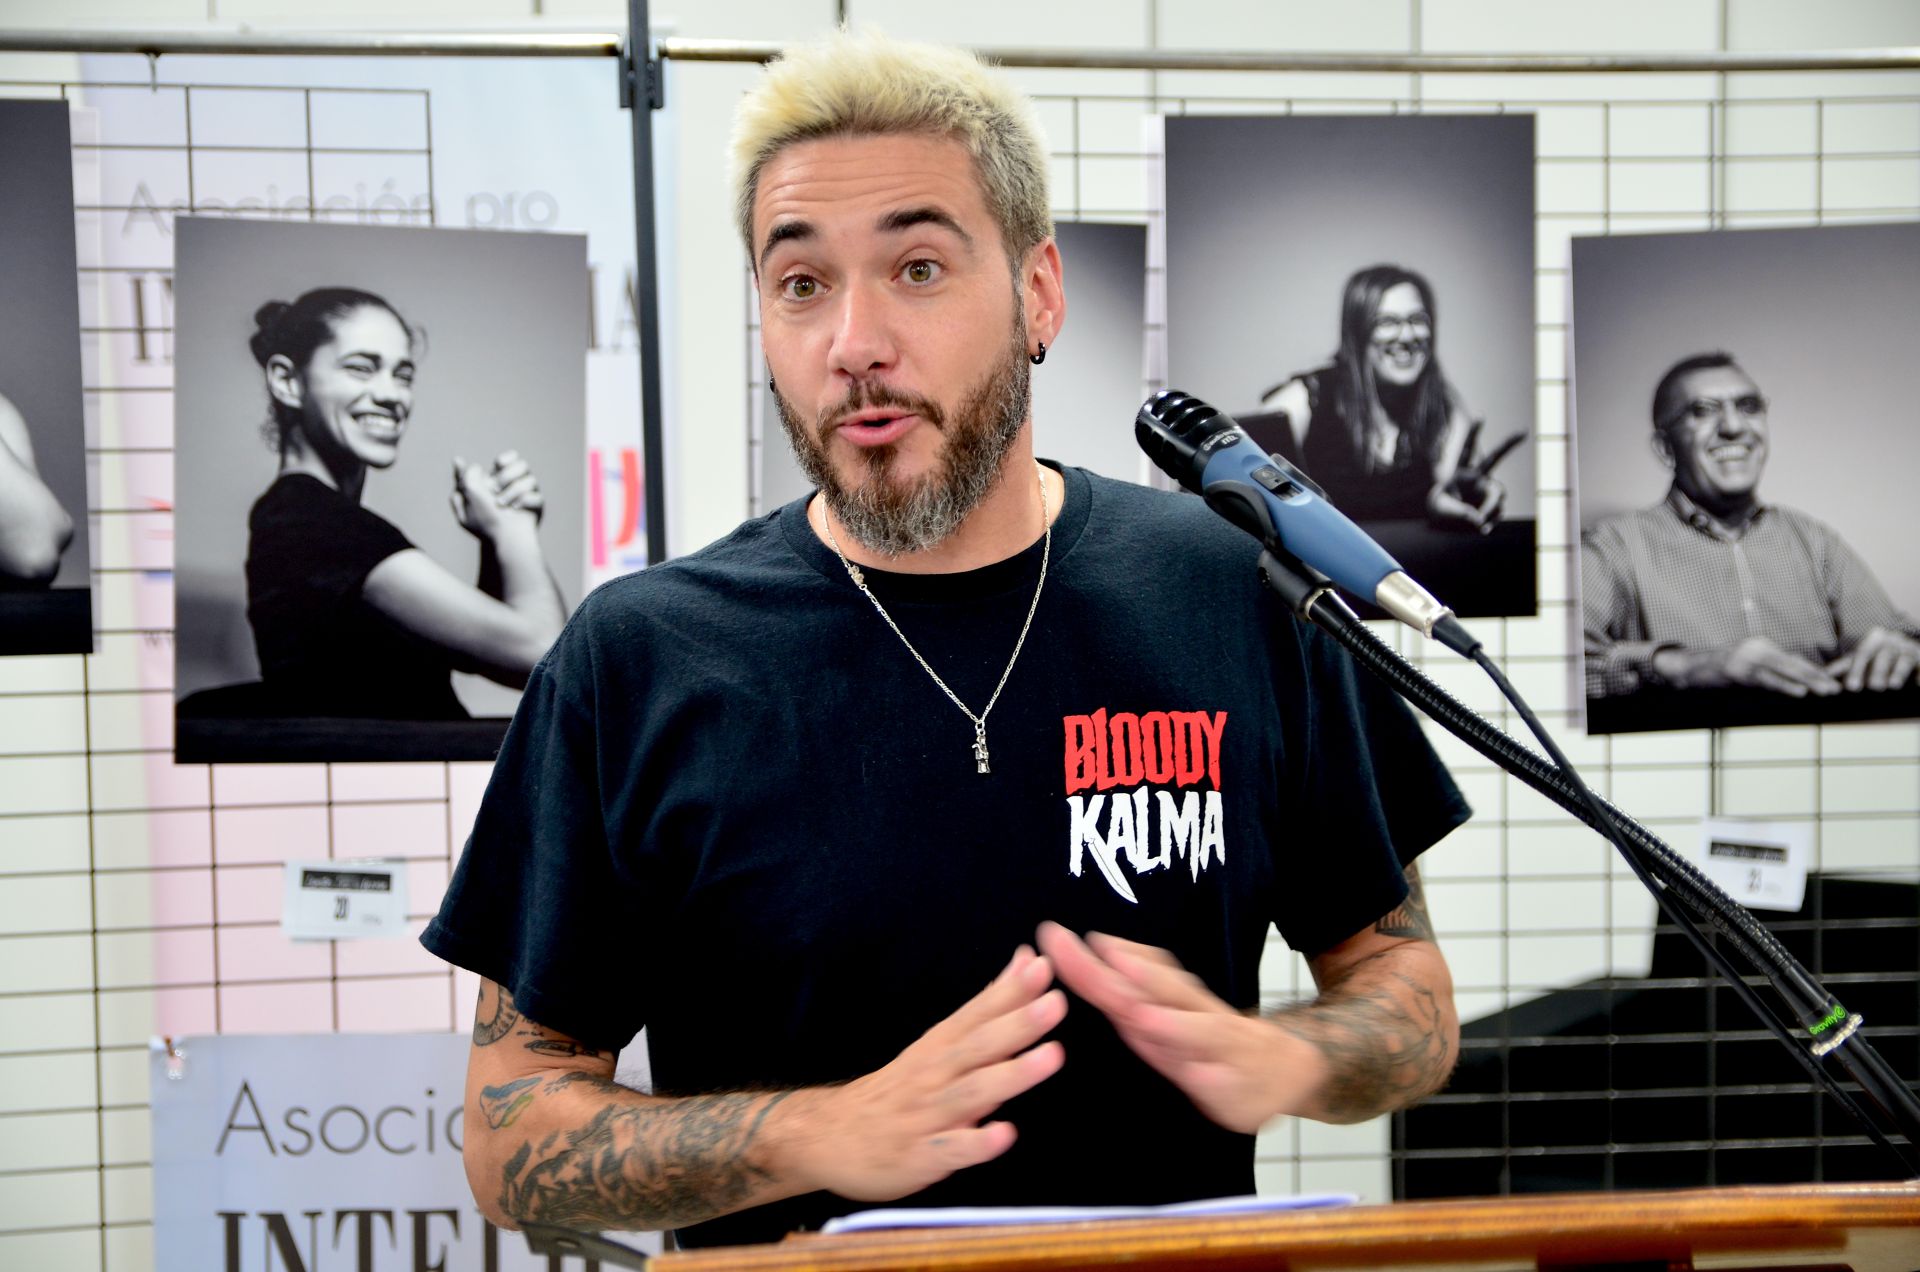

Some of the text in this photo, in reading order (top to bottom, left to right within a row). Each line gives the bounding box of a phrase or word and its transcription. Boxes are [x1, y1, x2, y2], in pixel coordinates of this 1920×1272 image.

[464, 190, 561, 232] pro
[1063, 707, 1228, 795] BLOODY
[1066, 786, 1225, 904] KALMA
